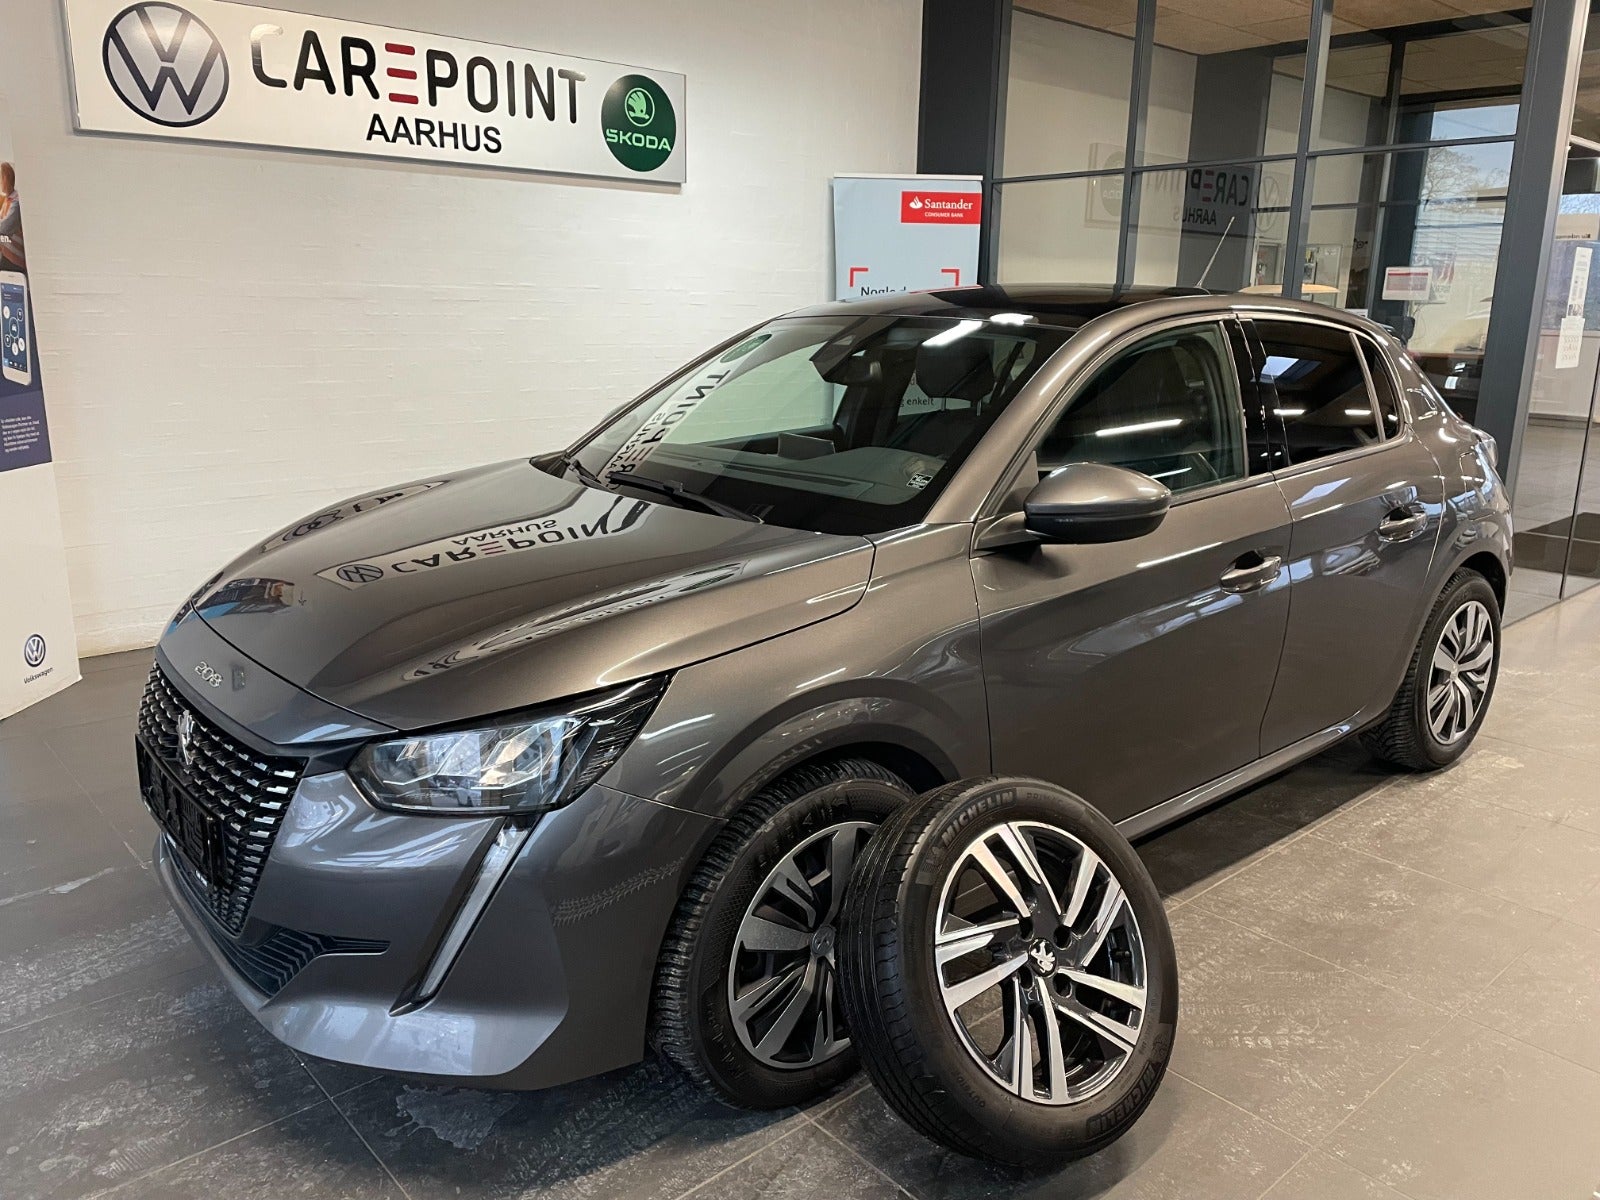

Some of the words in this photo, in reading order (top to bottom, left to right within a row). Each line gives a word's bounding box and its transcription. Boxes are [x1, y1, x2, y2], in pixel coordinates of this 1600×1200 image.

[250, 23, 587, 124] CAREPOINT
[365, 113, 503, 154] AARHUS
[924, 198, 974, 210] Santander
[860, 285, 896, 297] Nol
[906, 396, 935, 406] enkelt
[24, 667, 53, 684] Volkswagen
[194, 661, 222, 688] 208
[941, 791, 1014, 846] MICHELIN
